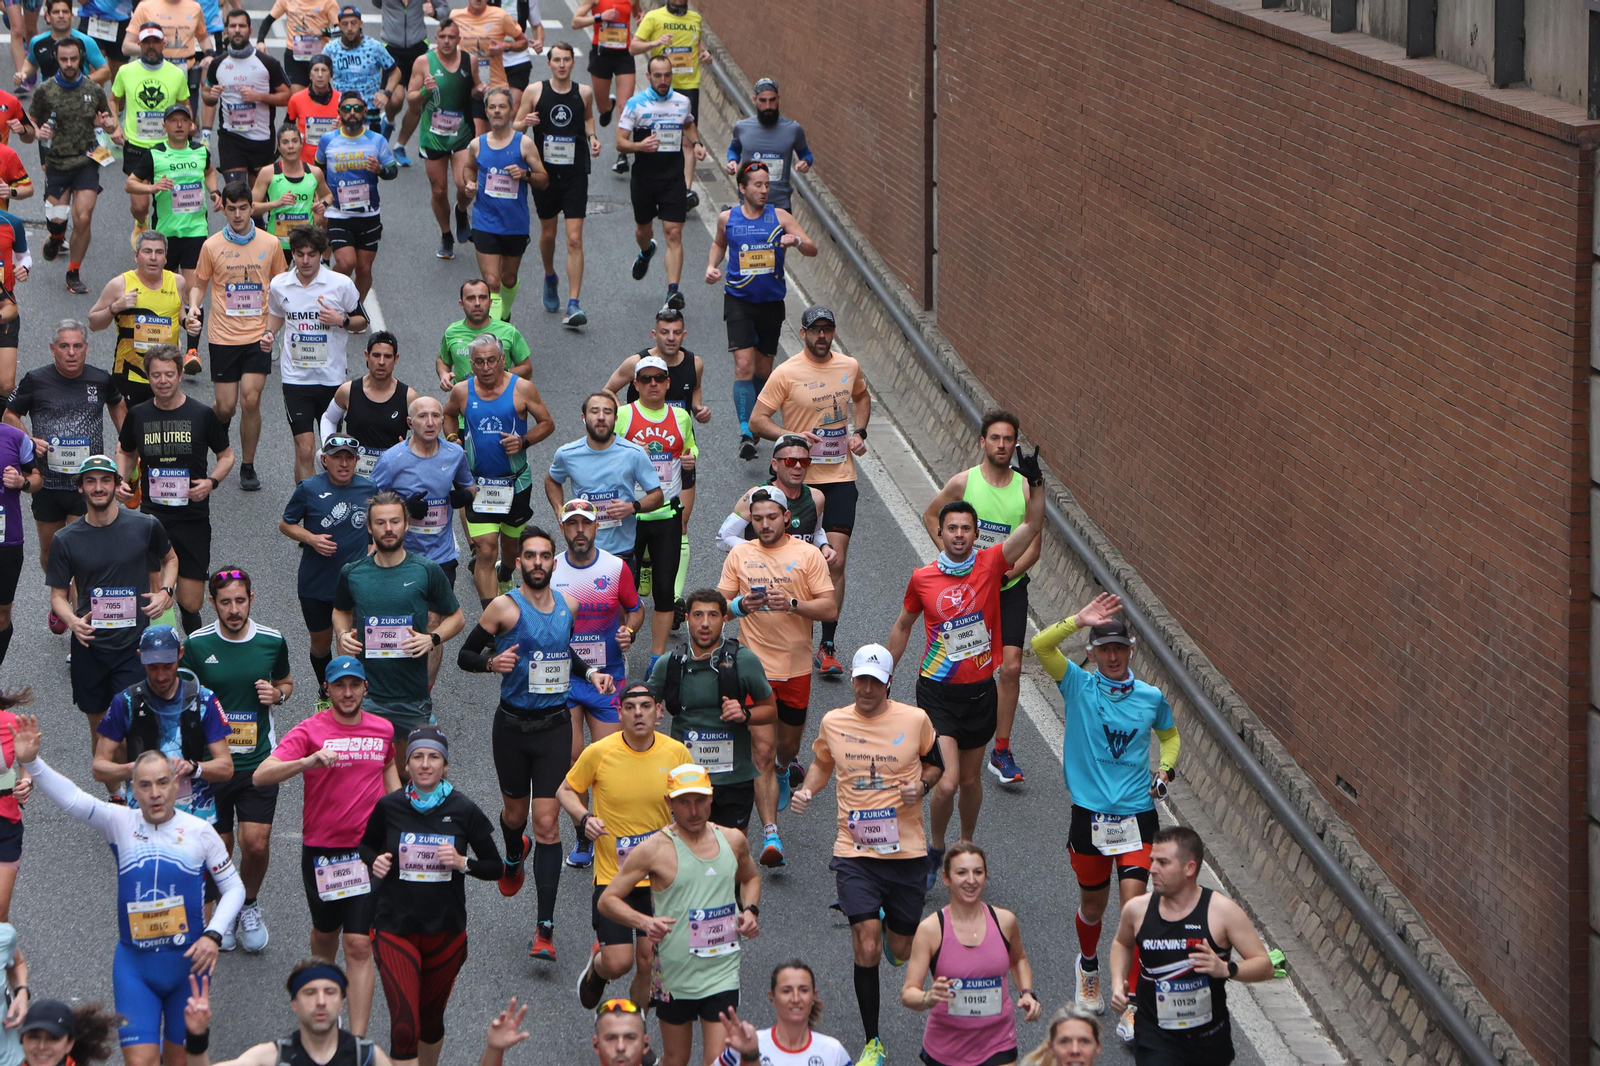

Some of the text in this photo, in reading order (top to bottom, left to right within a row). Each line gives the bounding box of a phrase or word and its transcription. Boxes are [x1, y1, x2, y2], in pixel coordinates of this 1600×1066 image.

[337, 54, 362, 71] COMO
[333, 151, 365, 163] TEAM
[169, 161, 198, 171] sano
[287, 213, 306, 221] ZURICH
[147, 317, 169, 325] ZURICH
[812, 389, 851, 403] Maratón Sevilla
[631, 426, 677, 448] ITALIA
[827, 428, 846, 437] ZURICH
[61, 438, 86, 446] ZURICH
[144, 430, 191, 445] RUN UTREG
[60, 450, 76, 458] 8594
[650, 453, 670, 461] URICH
[161, 469, 186, 477] ZURICH
[161, 481, 176, 489] 7435
[487, 478, 510, 486] ZURICH
[486, 490, 500, 498] 9691
[590, 493, 615, 501] ZURICH
[983, 521, 1007, 533] ZURICH
[979, 533, 995, 544] 9226
[747, 575, 793, 584] Maratón Sevilla
[105, 589, 131, 597] ZURICH
[104, 602, 121, 610] 7055
[381, 618, 407, 626] ZURICH
[954, 613, 980, 627] ZURICH
[380, 631, 397, 639] 7662
[574, 634, 601, 642] ZURICH
[957, 629, 975, 641] 9882
[546, 651, 569, 659] ZURICH
[574, 647, 591, 656] 7220
[544, 665, 562, 674] 8230
[225, 713, 252, 721] ZURICH
[698, 748, 720, 757] 10070
[845, 752, 897, 763] Maratón Sevilla
[699, 759, 720, 767] Fayssal
[862, 809, 891, 820] ZURICH
[863, 825, 881, 834] 7920
[418, 835, 449, 845] ZURICH
[331, 851, 361, 864] ZURICH
[416, 850, 436, 860] 7987
[404, 863, 424, 871] CAROL
[325, 877, 363, 892] DAVID OTERO
[707, 924, 724, 935] 7287
[139, 936, 172, 949] ZURICH
[966, 979, 996, 989] ZURICH
[1173, 980, 1204, 992] ZURICH
[963, 995, 988, 1005] 10192
[1171, 997, 1198, 1008] 10129
[969, 1008, 982, 1016] Ana
[1176, 1010, 1197, 1019] Benito
